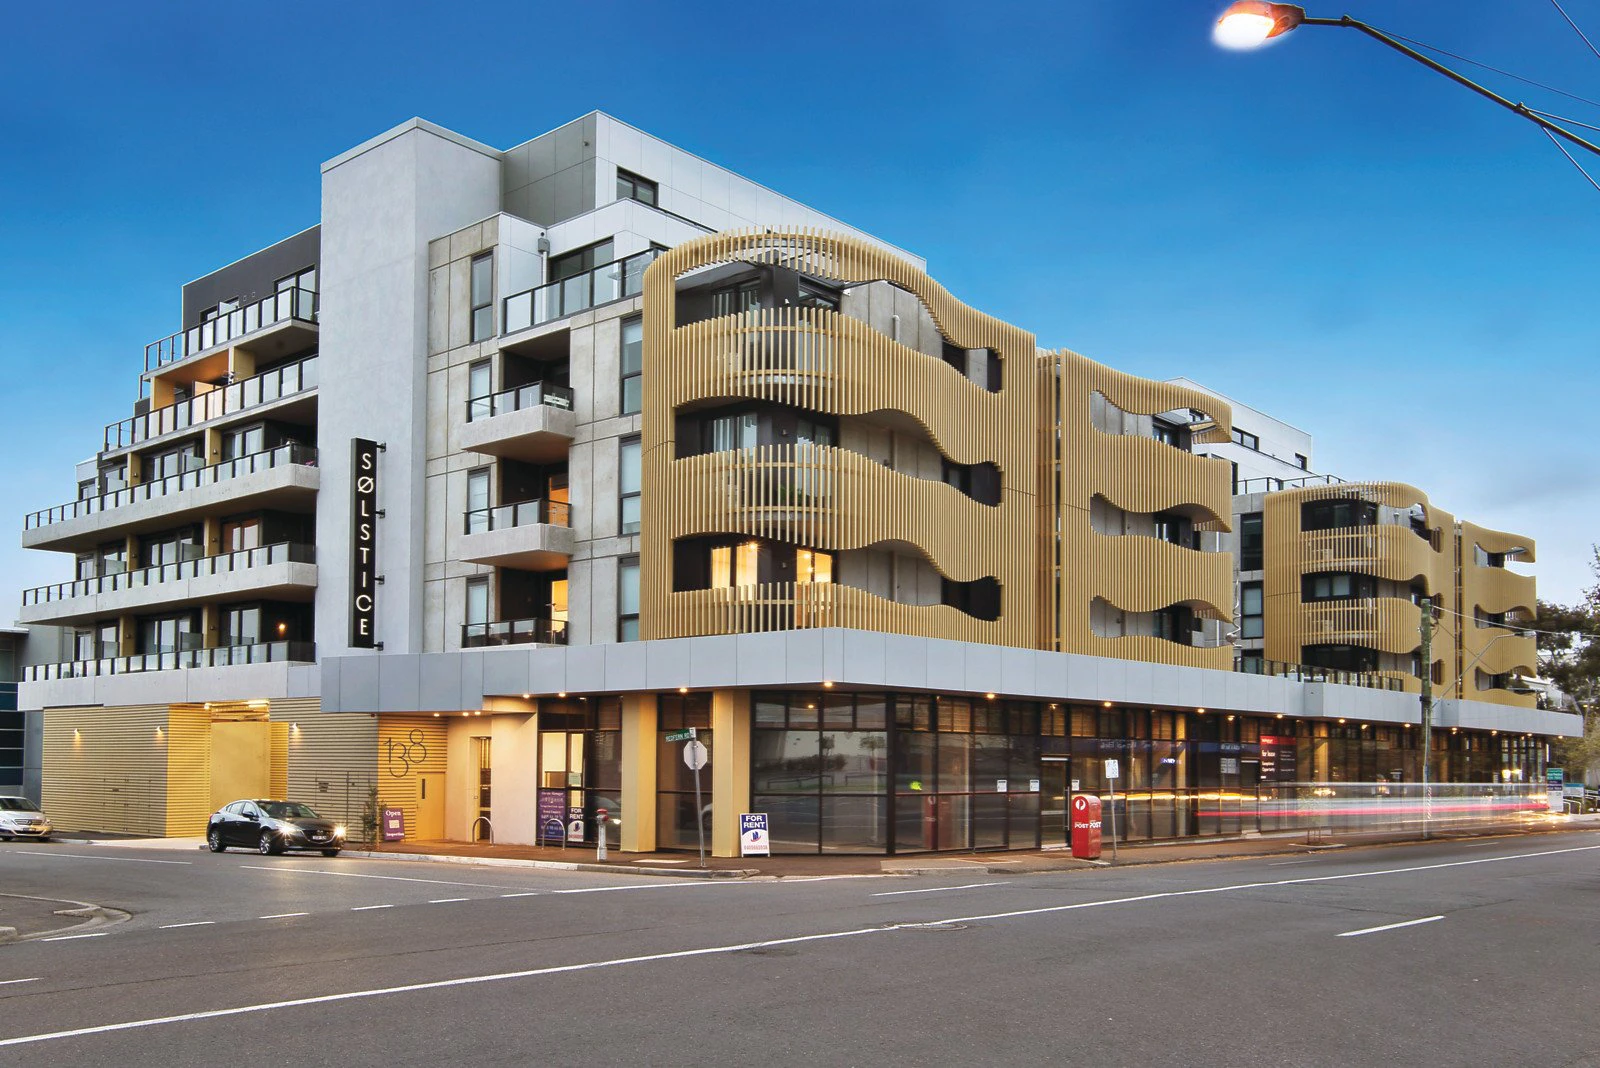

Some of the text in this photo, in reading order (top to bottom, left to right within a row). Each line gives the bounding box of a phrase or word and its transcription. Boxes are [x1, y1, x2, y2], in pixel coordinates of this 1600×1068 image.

[383, 729, 427, 778] 138
[385, 810, 402, 818] Open
[1090, 821, 1102, 829] POST
